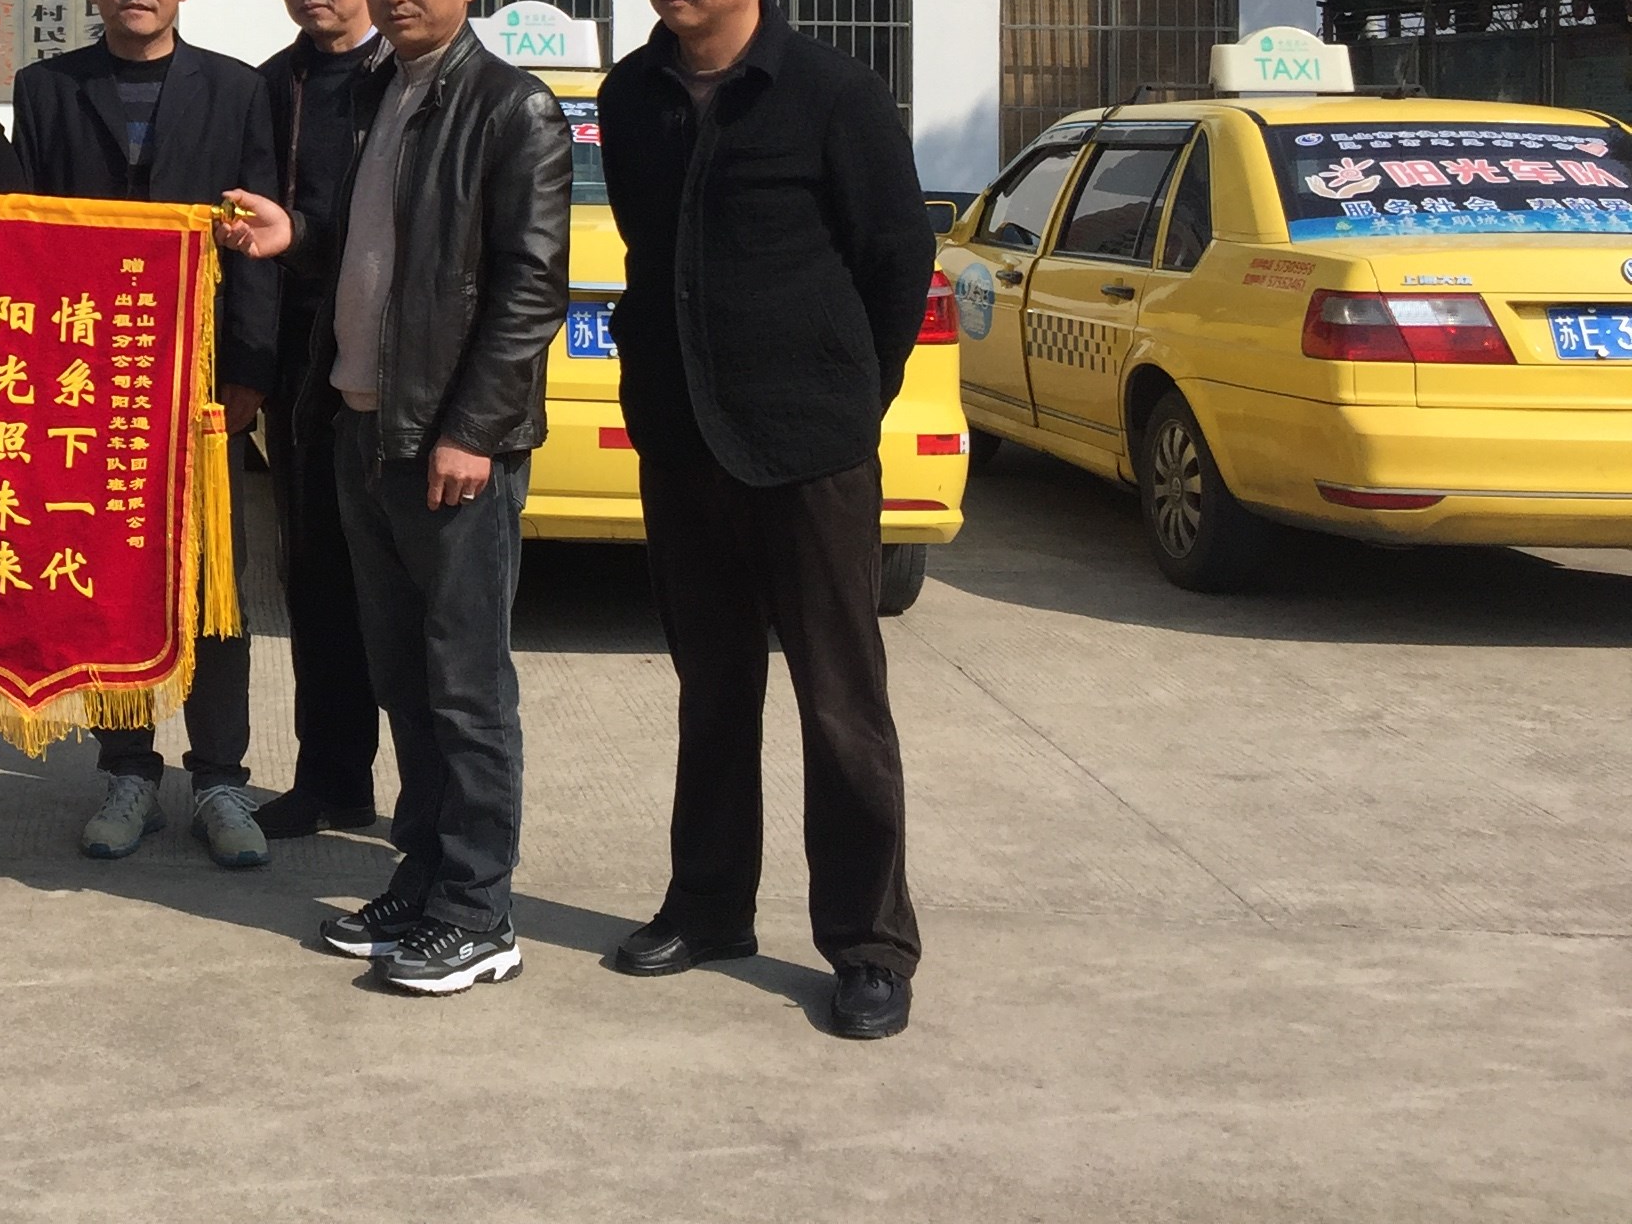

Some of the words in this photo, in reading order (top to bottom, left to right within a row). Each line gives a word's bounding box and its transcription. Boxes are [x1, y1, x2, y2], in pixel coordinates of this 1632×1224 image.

[499, 32, 567, 56] TAXI
[1253, 57, 1321, 81] TAXI
[1379, 157, 1630, 189] 阳光车队
[125, 293, 158, 550] 昆山市公共交通集团有限公司
[39, 293, 103, 599] 情系下一代
